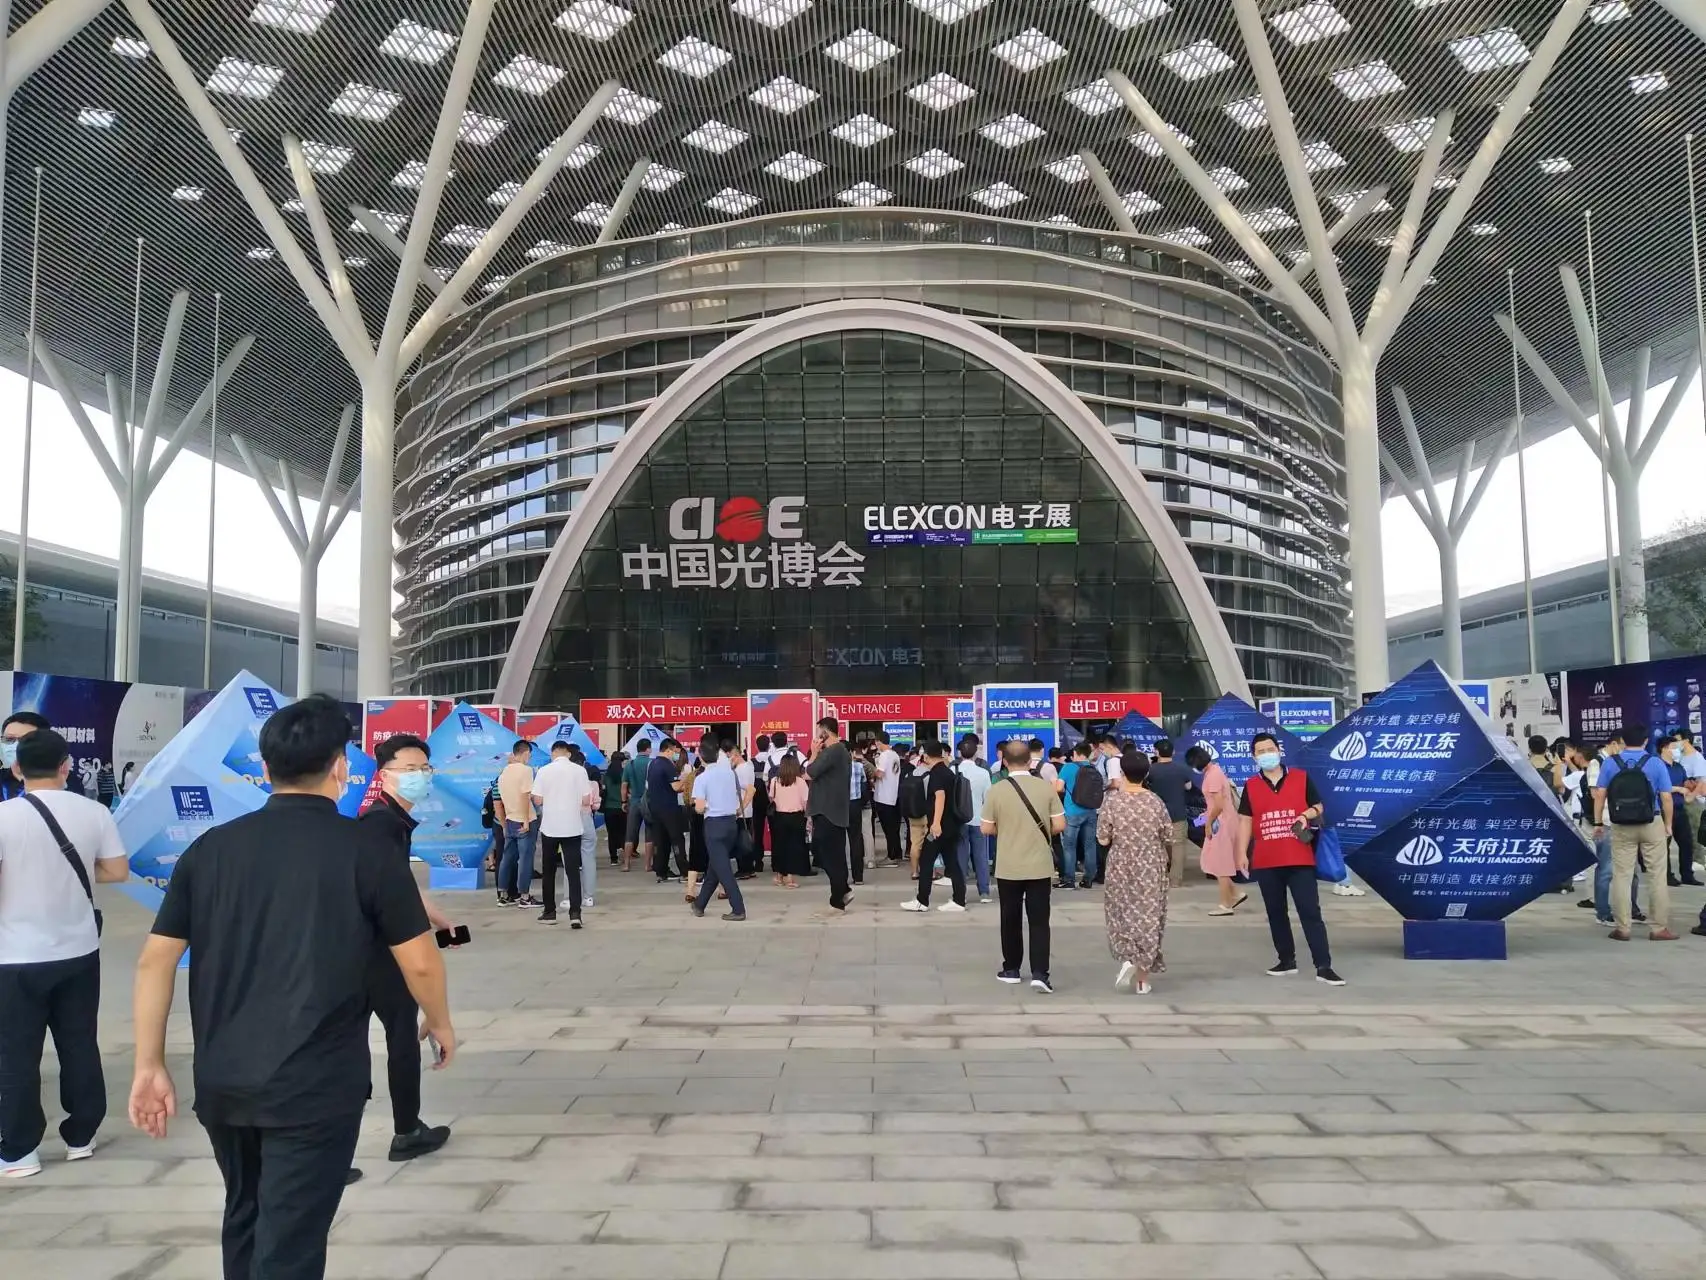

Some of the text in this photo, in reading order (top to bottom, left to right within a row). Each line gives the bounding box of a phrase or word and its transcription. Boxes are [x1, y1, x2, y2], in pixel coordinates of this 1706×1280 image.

[864, 503, 1071, 531] ELEXCON 电子展
[622, 541, 866, 589] 中国光博会
[606, 704, 731, 719] 观众入口 ENTRANCE
[840, 703, 902, 714] ENTRANCE
[988, 700, 1027, 709] ELEXCON
[1069, 699, 1128, 713] 出口 EXIT
[1348, 712, 1461, 726] 光纤光缆 架空导线
[1372, 731, 1461, 750] 天府江东
[1369, 751, 1453, 759] TIANFU JIANGDONG
[1326, 768, 1438, 782] 中国制造 联接你我
[1409, 817, 1552, 831] 光纤光缆 架空导线
[1449, 837, 1553, 856] 天府江东
[1448, 856, 1549, 864] TIANFU JIANGDONG
[1398, 872, 1534, 886] 中国制造 联接你我
